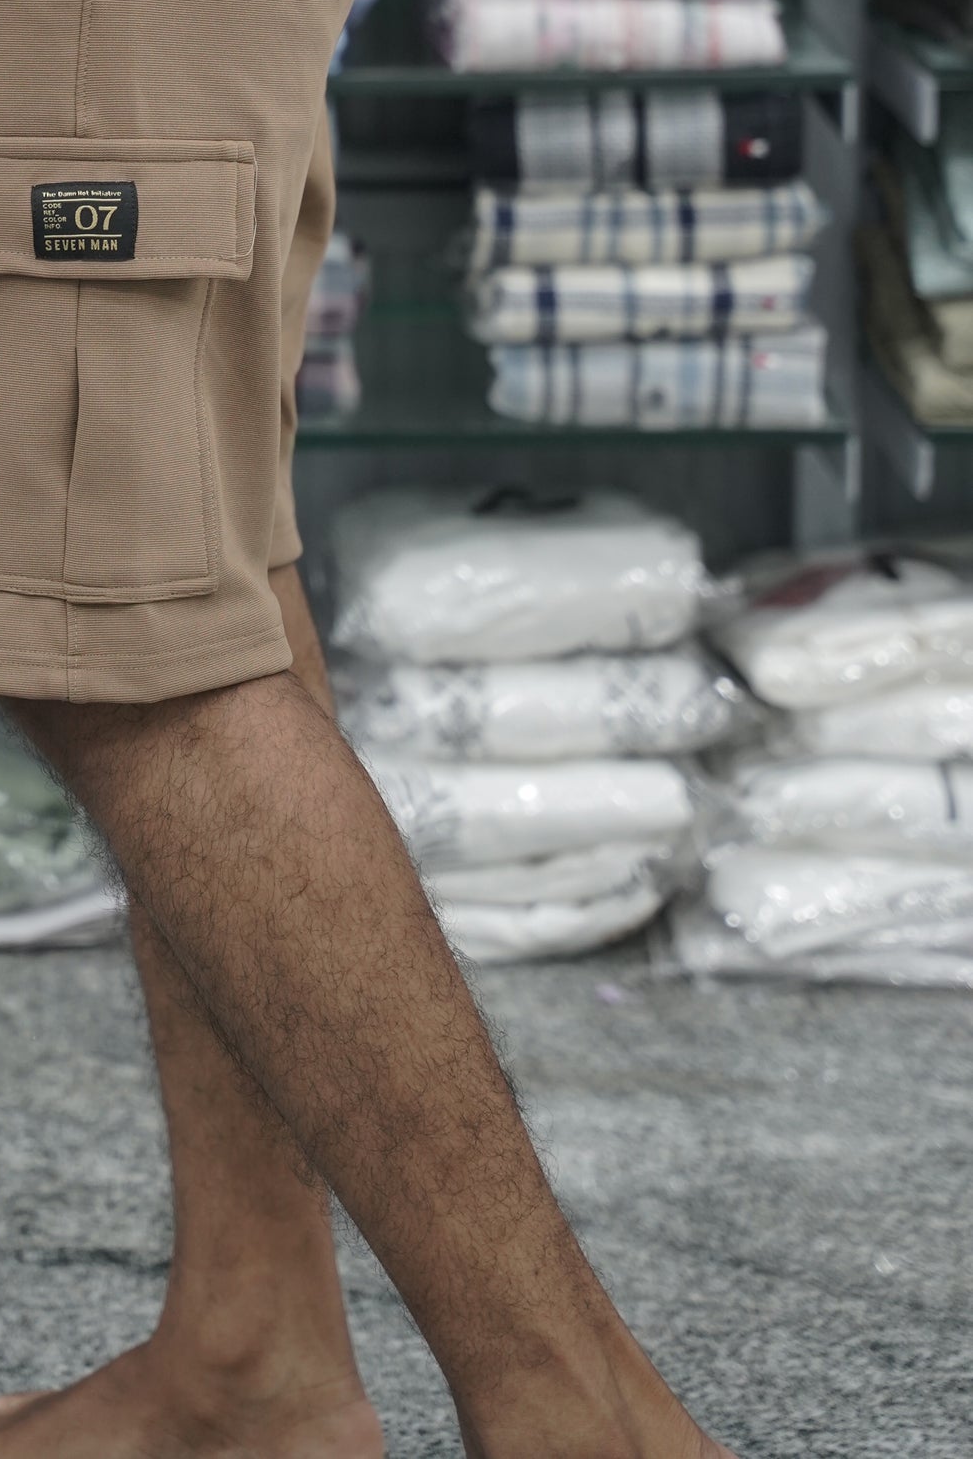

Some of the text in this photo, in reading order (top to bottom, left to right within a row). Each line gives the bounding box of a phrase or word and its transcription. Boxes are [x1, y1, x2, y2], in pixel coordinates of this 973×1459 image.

[74, 205, 118, 230] 07
[45, 239, 118, 251] SEVEN MAN
